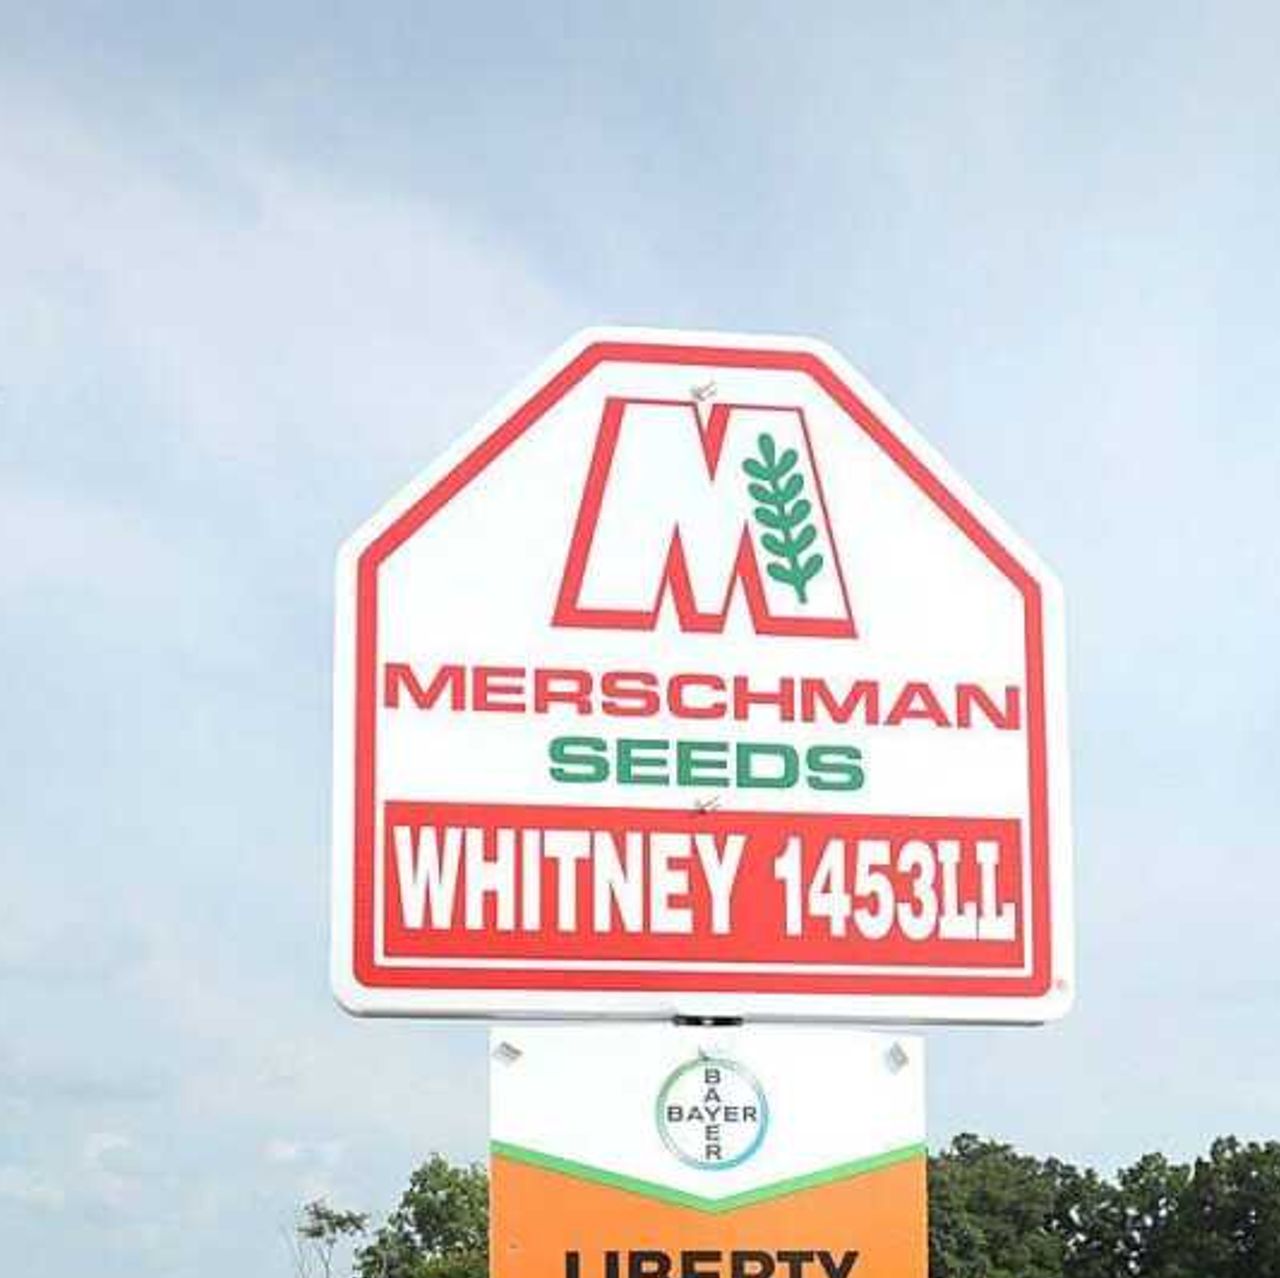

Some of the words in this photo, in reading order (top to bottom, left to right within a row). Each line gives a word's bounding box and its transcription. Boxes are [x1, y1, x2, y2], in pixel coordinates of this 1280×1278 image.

[383, 662, 1021, 732] MERSCHMAN
[548, 735, 866, 792] SEEDS
[392, 824, 748, 936] WHITNEY
[773, 835, 1017, 943] 1453LL
[666, 1105, 757, 1123] BAYER
[703, 1067, 722, 1161] BAYER
